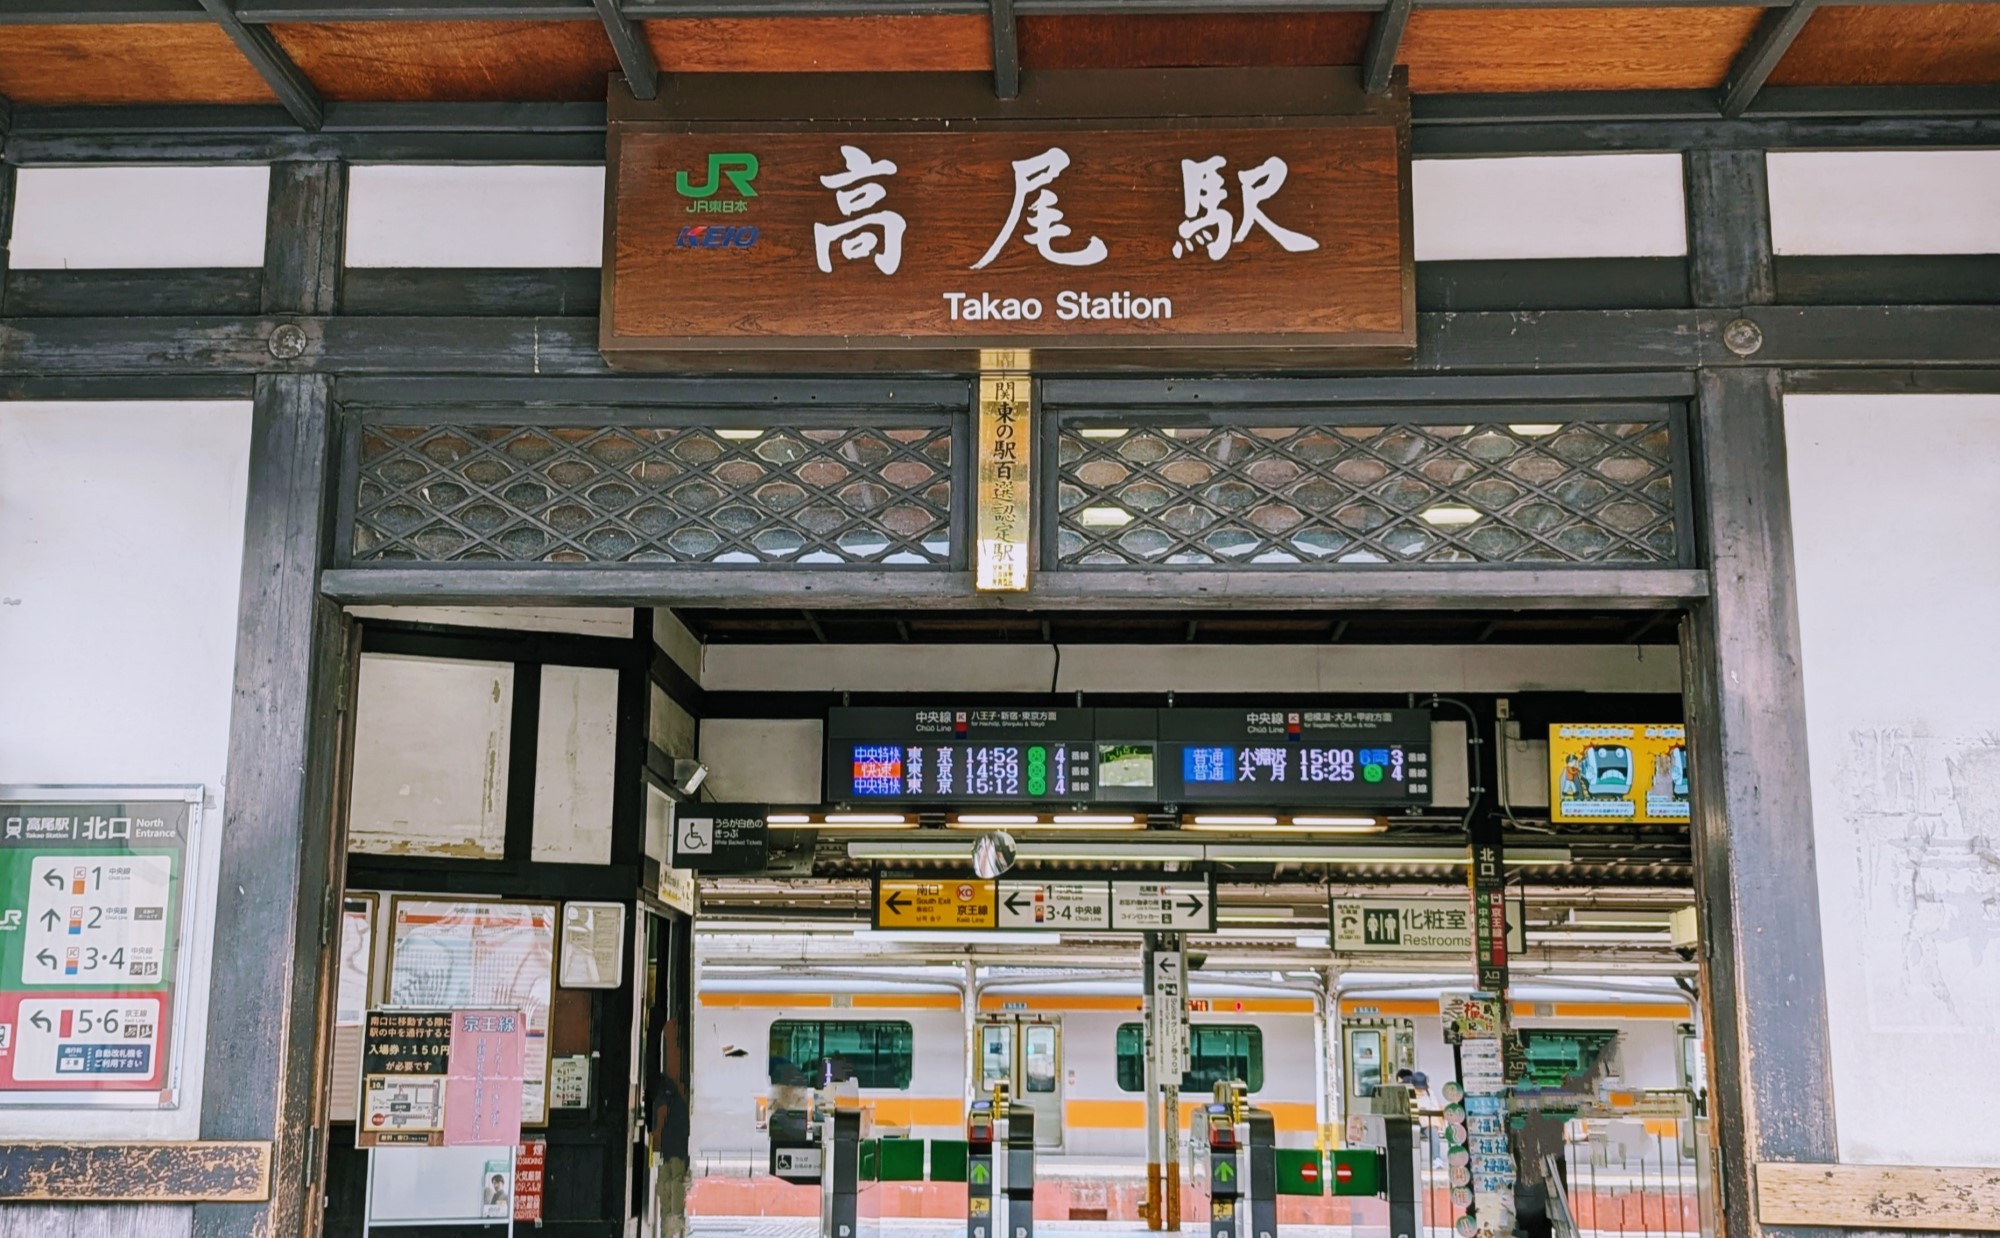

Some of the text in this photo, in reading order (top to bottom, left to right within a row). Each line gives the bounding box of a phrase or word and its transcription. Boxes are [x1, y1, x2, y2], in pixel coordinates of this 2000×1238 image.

[676, 153, 759, 197] JR
[685, 200, 748, 213] JR東日本
[814, 144, 1320, 275] 高尾駅
[675, 225, 760, 248] KEIO
[942, 290, 1172, 320] Takao Station
[993, 381, 1017, 562] 関東の駅百選認定駅
[915, 711, 952, 723] 中央線
[971, 711, 1057, 721] 八王子・新宿・東京方面
[1246, 712, 1284, 724] 中央線
[936, 724, 952, 732] Line
[1268, 725, 1285, 733] Line
[854, 746, 1066, 764] 中央特快 東京 14:52 4
[1192, 748, 1224, 764] 普通
[1238, 748, 1287, 766] 小淵沢
[1299, 748, 1354, 765] 15:00
[1390, 749, 1404, 765] 3
[861, 763, 1065, 779] 快速 東京 14:59 1
[1192, 765, 1404, 782] 普通 大月 15:25 4
[854, 778, 1066, 795] 中央特快 東京 15:12 4
[26, 815, 132, 840] 高尾駅 北口
[135, 818, 165, 828] North
[715, 818, 764, 829] うらが白色の
[135, 828, 176, 838] Entrance
[714, 829, 739, 839] きっぷ
[1480, 847, 1495, 876] 北口
[108, 867, 131, 875] 中央線
[91, 866, 102, 891] 1
[917, 884, 940, 896] 南口
[958, 889, 973, 897] KO
[1046, 884, 1053, 900] 1
[916, 897, 951, 905] South Exit
[105, 907, 128, 915] 中央線
[957, 905, 988, 916] 京王線
[1075, 906, 1102, 915] 中央線
[87, 906, 103, 929] 2
[1402, 908, 1467, 930] 化粧室
[1402, 935, 1472, 946] Restrooms
[130, 946, 153, 954] 中央線
[1484, 970, 1500, 980] 入口
[124, 1009, 148, 1017] 京王線
[370, 1016, 452, 1027] 南口に移動する際に
[463, 1015, 516, 1033] 京王線
[369, 1027, 451, 1038] 駅の中を通行すると
[95, 1048, 143, 1058] 自動改札機を
[94, 1059, 143, 1068] ご利用下さい
[385, 1061, 432, 1071] が必要です
